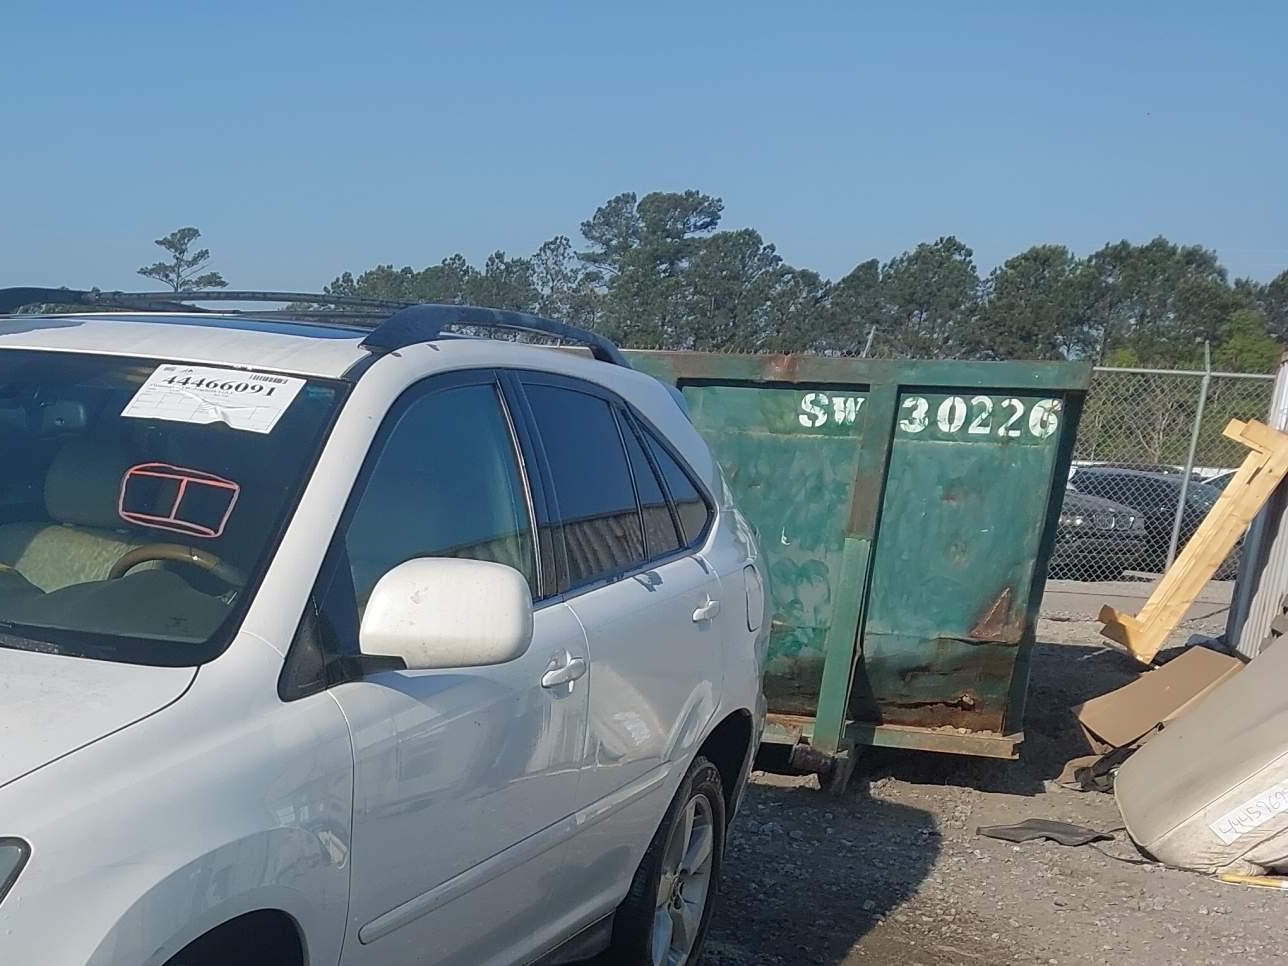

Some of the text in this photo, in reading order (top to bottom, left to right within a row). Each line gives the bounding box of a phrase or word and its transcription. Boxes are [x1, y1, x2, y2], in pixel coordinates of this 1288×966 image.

[163, 375, 276, 397] 44466091
[799, 393, 1063, 438] SW 30226
